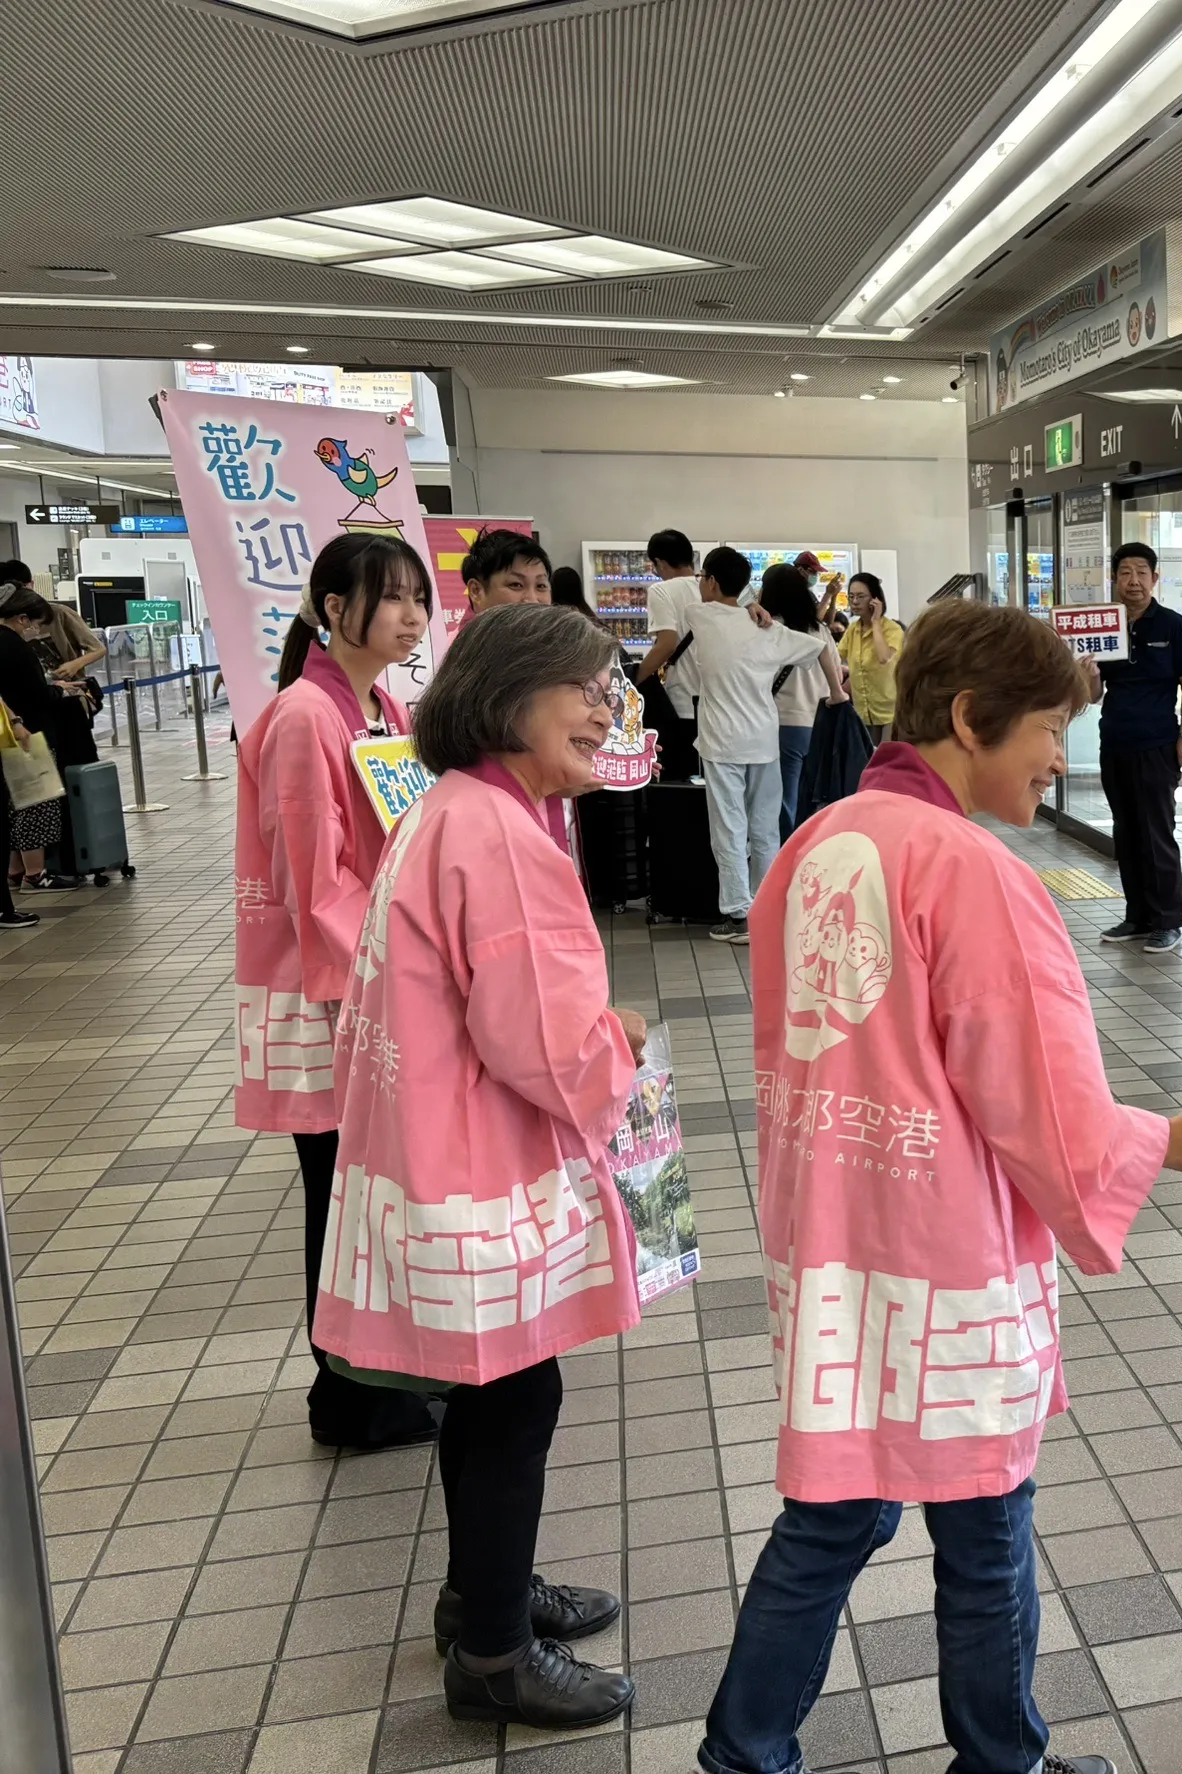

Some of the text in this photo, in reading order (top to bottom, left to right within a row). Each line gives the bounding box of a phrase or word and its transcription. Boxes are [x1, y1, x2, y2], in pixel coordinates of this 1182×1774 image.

[1019, 318, 1122, 385] Momotaro's City of Okayama
[1101, 425, 1123, 458] EXIT
[1010, 444, 1033, 482] 出口
[142, 610, 168, 621] 入口
[1057, 612, 1118, 630] 平成租車
[1063, 635, 1119, 653] TS租車
[608, 1142, 684, 1175] OKAYAMA
[834, 1152, 936, 1183] AIRPORT
